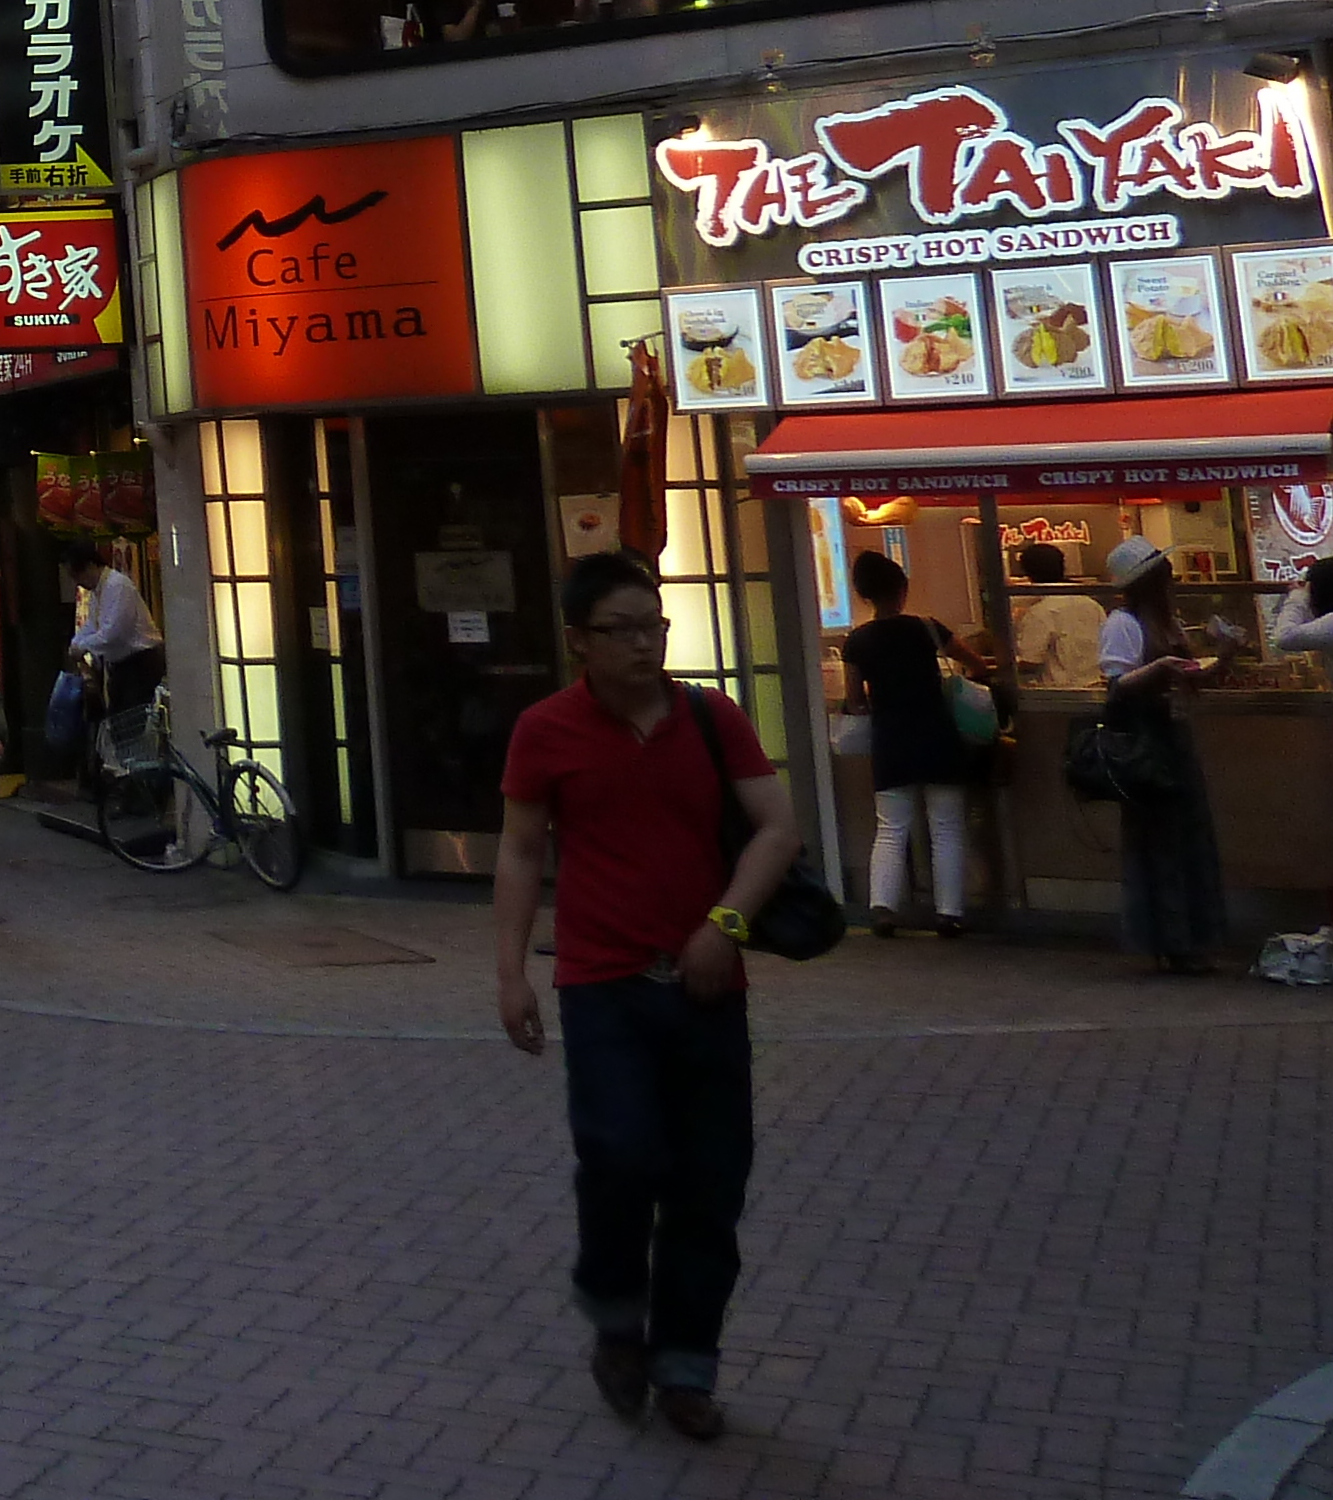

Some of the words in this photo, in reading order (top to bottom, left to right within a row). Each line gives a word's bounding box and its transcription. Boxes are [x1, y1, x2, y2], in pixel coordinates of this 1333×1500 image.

[9, 165, 88, 187] 手前右折
[659, 142, 866, 242] THE
[817, 87, 1311, 221] TAIYAKI
[805, 242, 910, 267] CRISPY
[923, 236, 984, 258] HOT
[997, 221, 1170, 252] SANDWICH
[247, 243, 357, 288] Cafe
[14, 314, 70, 326] SUKIYA
[204, 304, 427, 355] Miyama
[773, 477, 841, 492] CRISPY
[851, 477, 890, 491] HOT
[897, 474, 1007, 491] SANDWICH
[1039, 470, 1114, 485] CRISPY
[1125, 468, 1169, 482] HOT
[1177, 464, 1299, 481] SANDWICH
